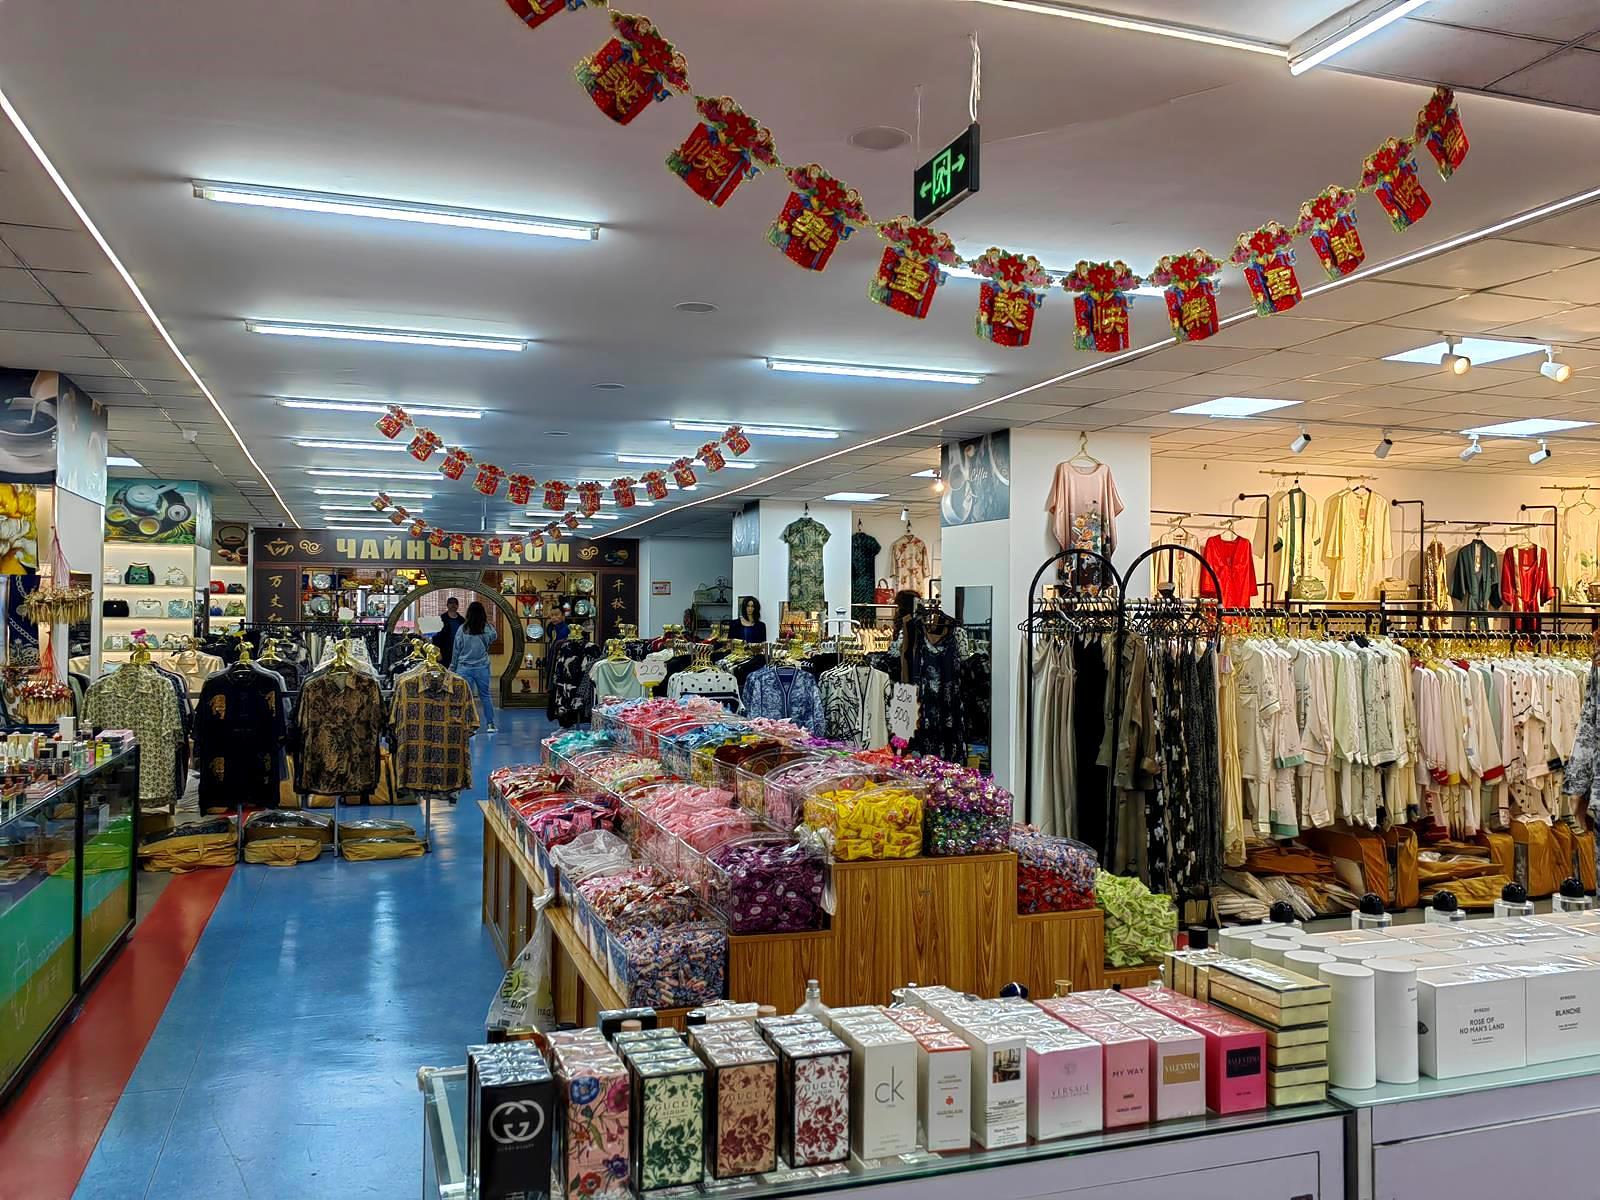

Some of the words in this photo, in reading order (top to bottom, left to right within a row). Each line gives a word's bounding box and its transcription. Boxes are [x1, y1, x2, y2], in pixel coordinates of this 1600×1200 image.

[498, 541, 570, 564] ДОМ
[1470, 1018, 1485, 1026] ROSE
[1488, 1023, 1505, 1031] LAND
[1112, 1070, 1124, 1078] MY
[1126, 1067, 1144, 1076] WAY
[654, 1099, 694, 1111] GUCCI
